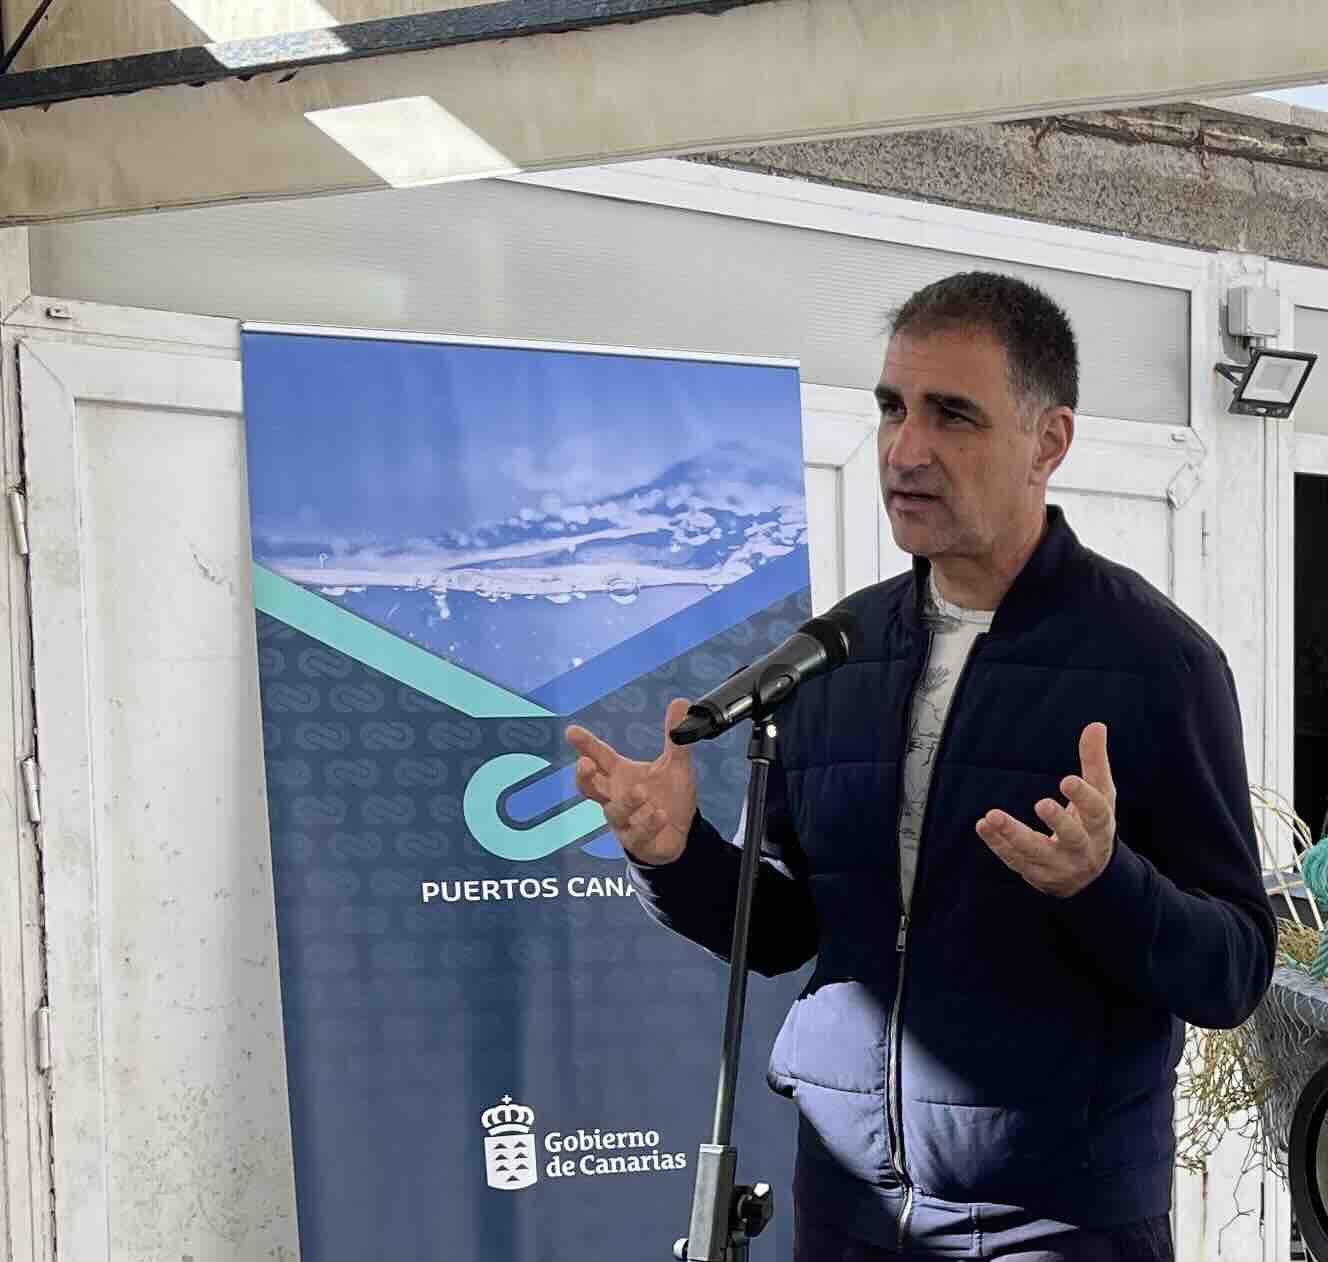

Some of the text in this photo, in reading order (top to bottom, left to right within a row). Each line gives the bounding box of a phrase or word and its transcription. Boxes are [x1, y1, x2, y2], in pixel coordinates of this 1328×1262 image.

[421, 877, 559, 903] PUERTOS
[544, 1129, 660, 1152] Gobierno
[545, 1152, 687, 1178] de Canarias
